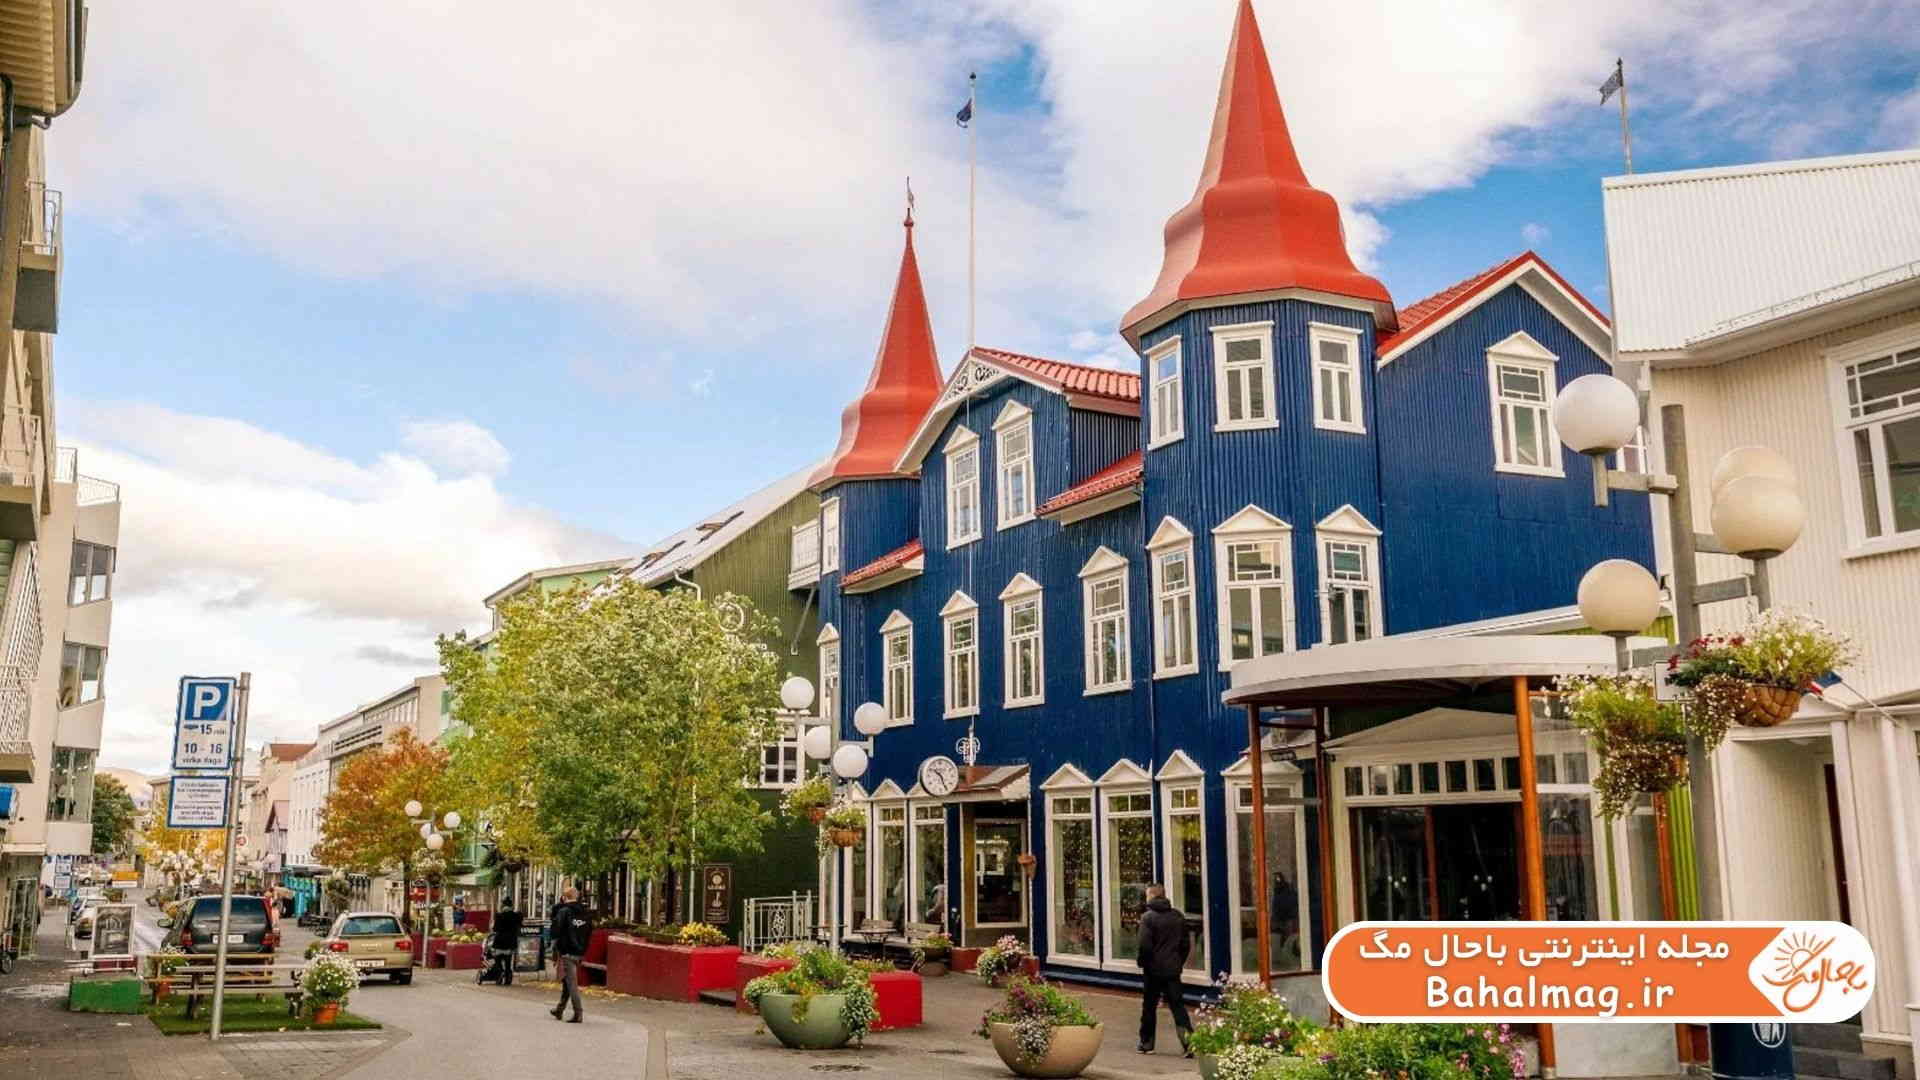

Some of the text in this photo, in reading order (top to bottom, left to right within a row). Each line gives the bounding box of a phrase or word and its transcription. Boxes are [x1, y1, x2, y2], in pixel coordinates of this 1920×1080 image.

[193, 686, 222, 719] P
[200, 724, 213, 735] 15
[184, 743, 198, 754] 10
[210, 743, 223, 754] 16
